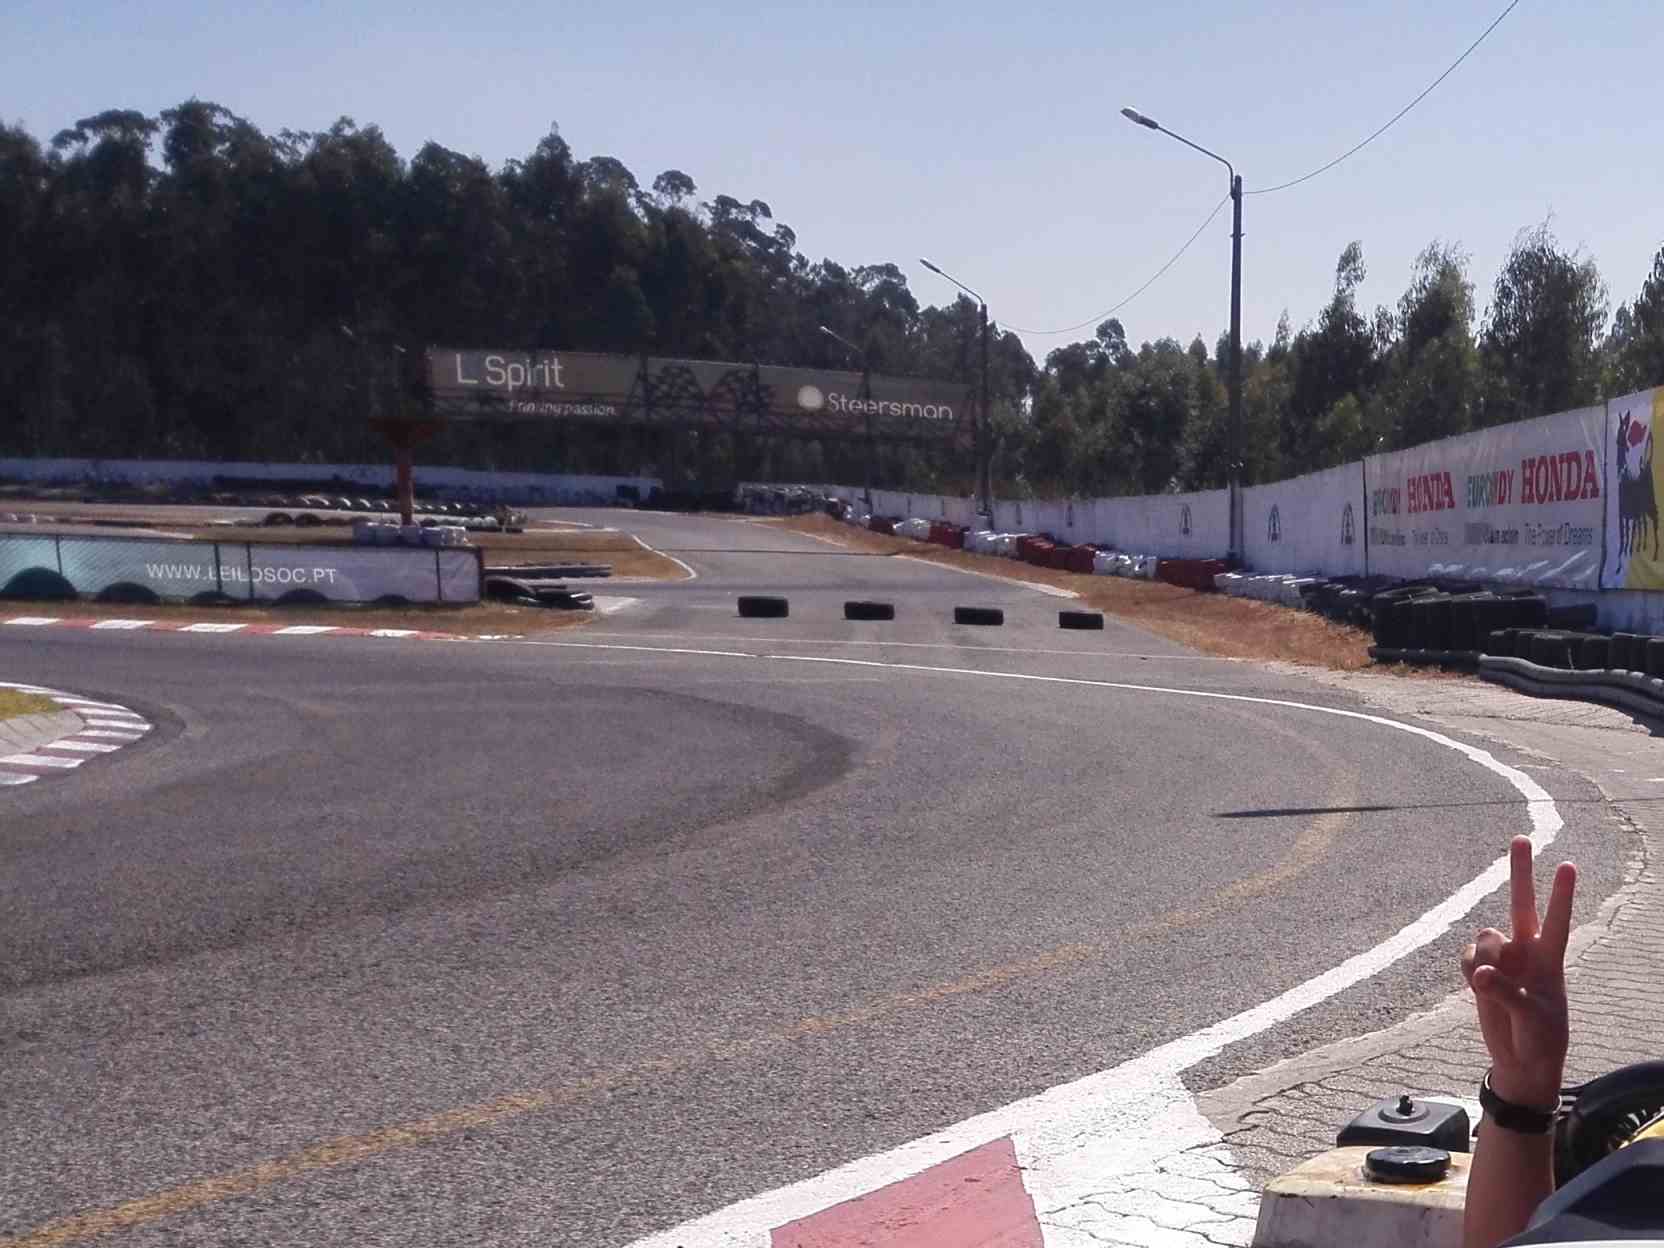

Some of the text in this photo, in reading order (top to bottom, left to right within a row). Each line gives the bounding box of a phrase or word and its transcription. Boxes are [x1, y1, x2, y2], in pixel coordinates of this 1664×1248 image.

[456, 353, 565, 391] L Spirit
[828, 392, 953, 420] Steersman
[1407, 470, 1456, 514] HONDA
[1520, 449, 1599, 505] HONDA
